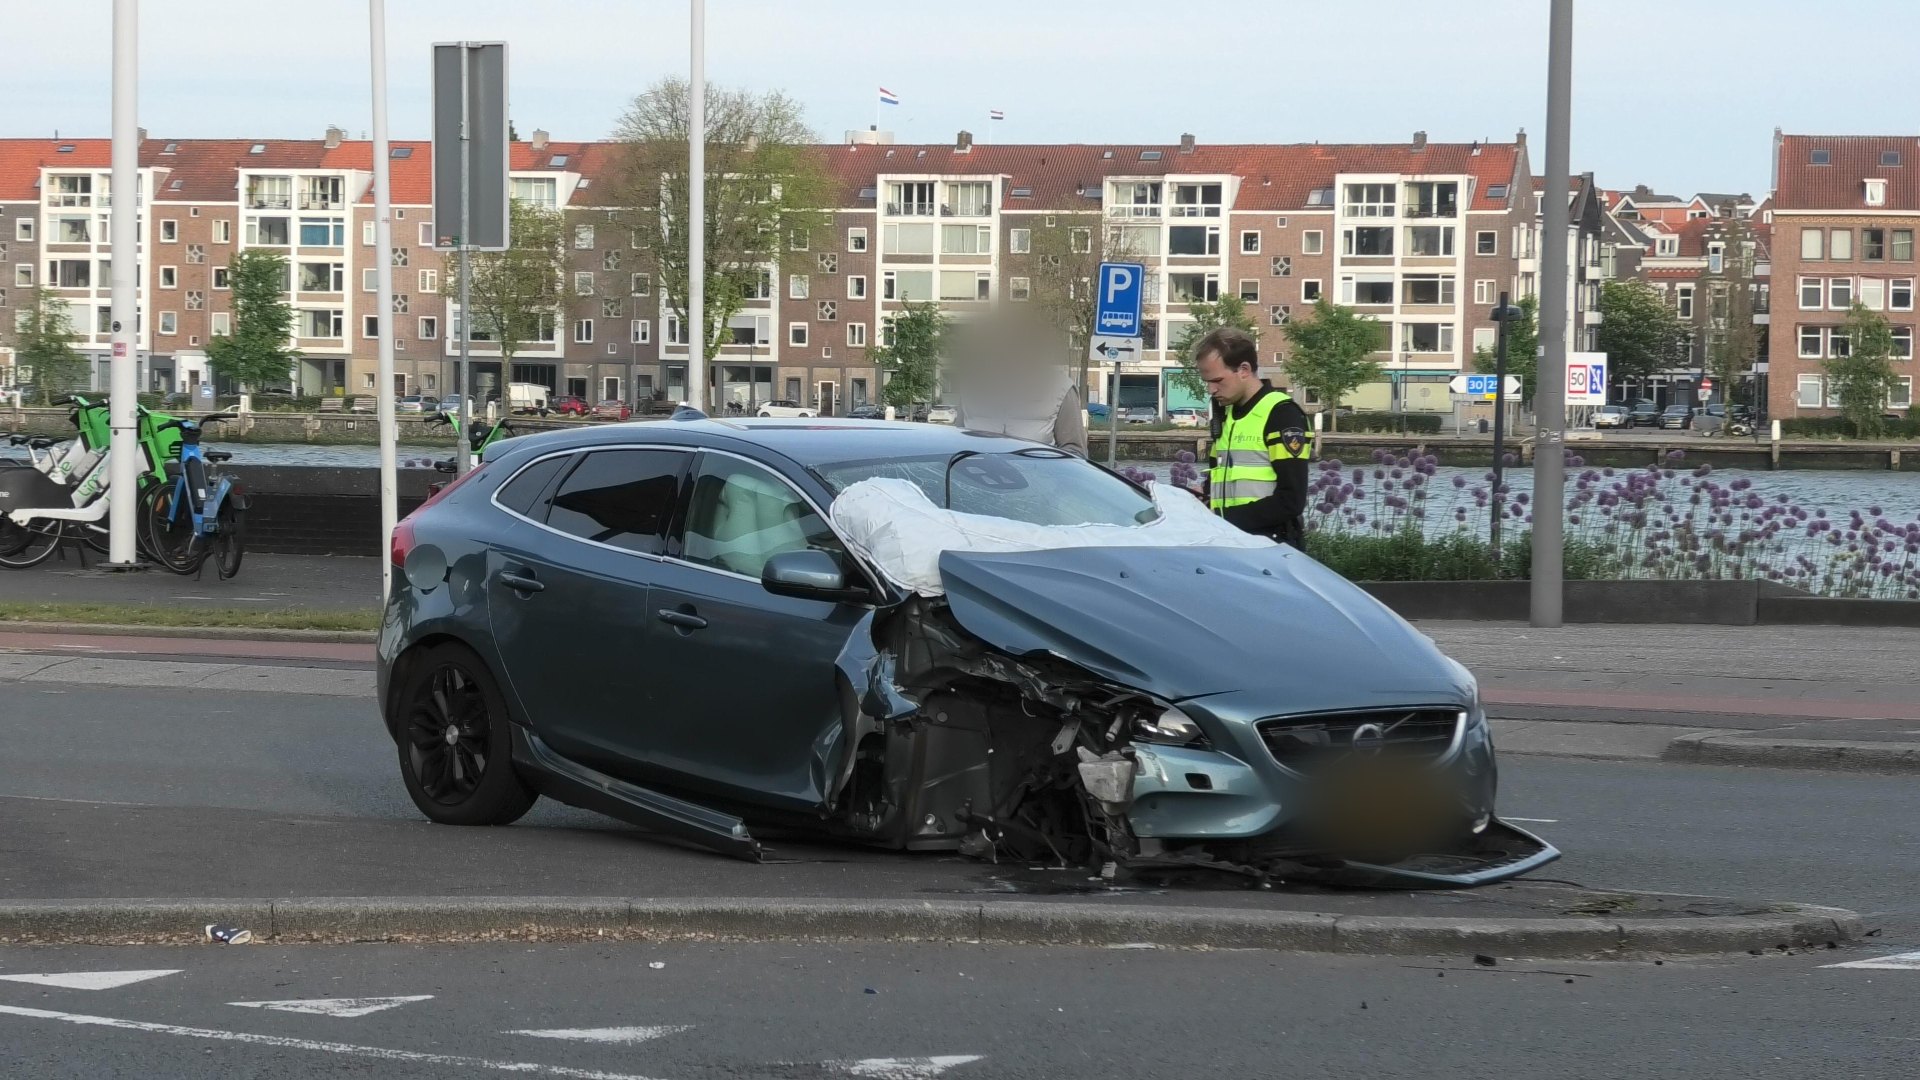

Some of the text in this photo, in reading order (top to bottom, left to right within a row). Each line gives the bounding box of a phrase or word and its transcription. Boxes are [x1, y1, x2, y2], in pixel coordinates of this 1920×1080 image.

[1108, 268, 1132, 303] P
[1469, 380, 1483, 390] 30
[1570, 372, 1585, 386] 50
